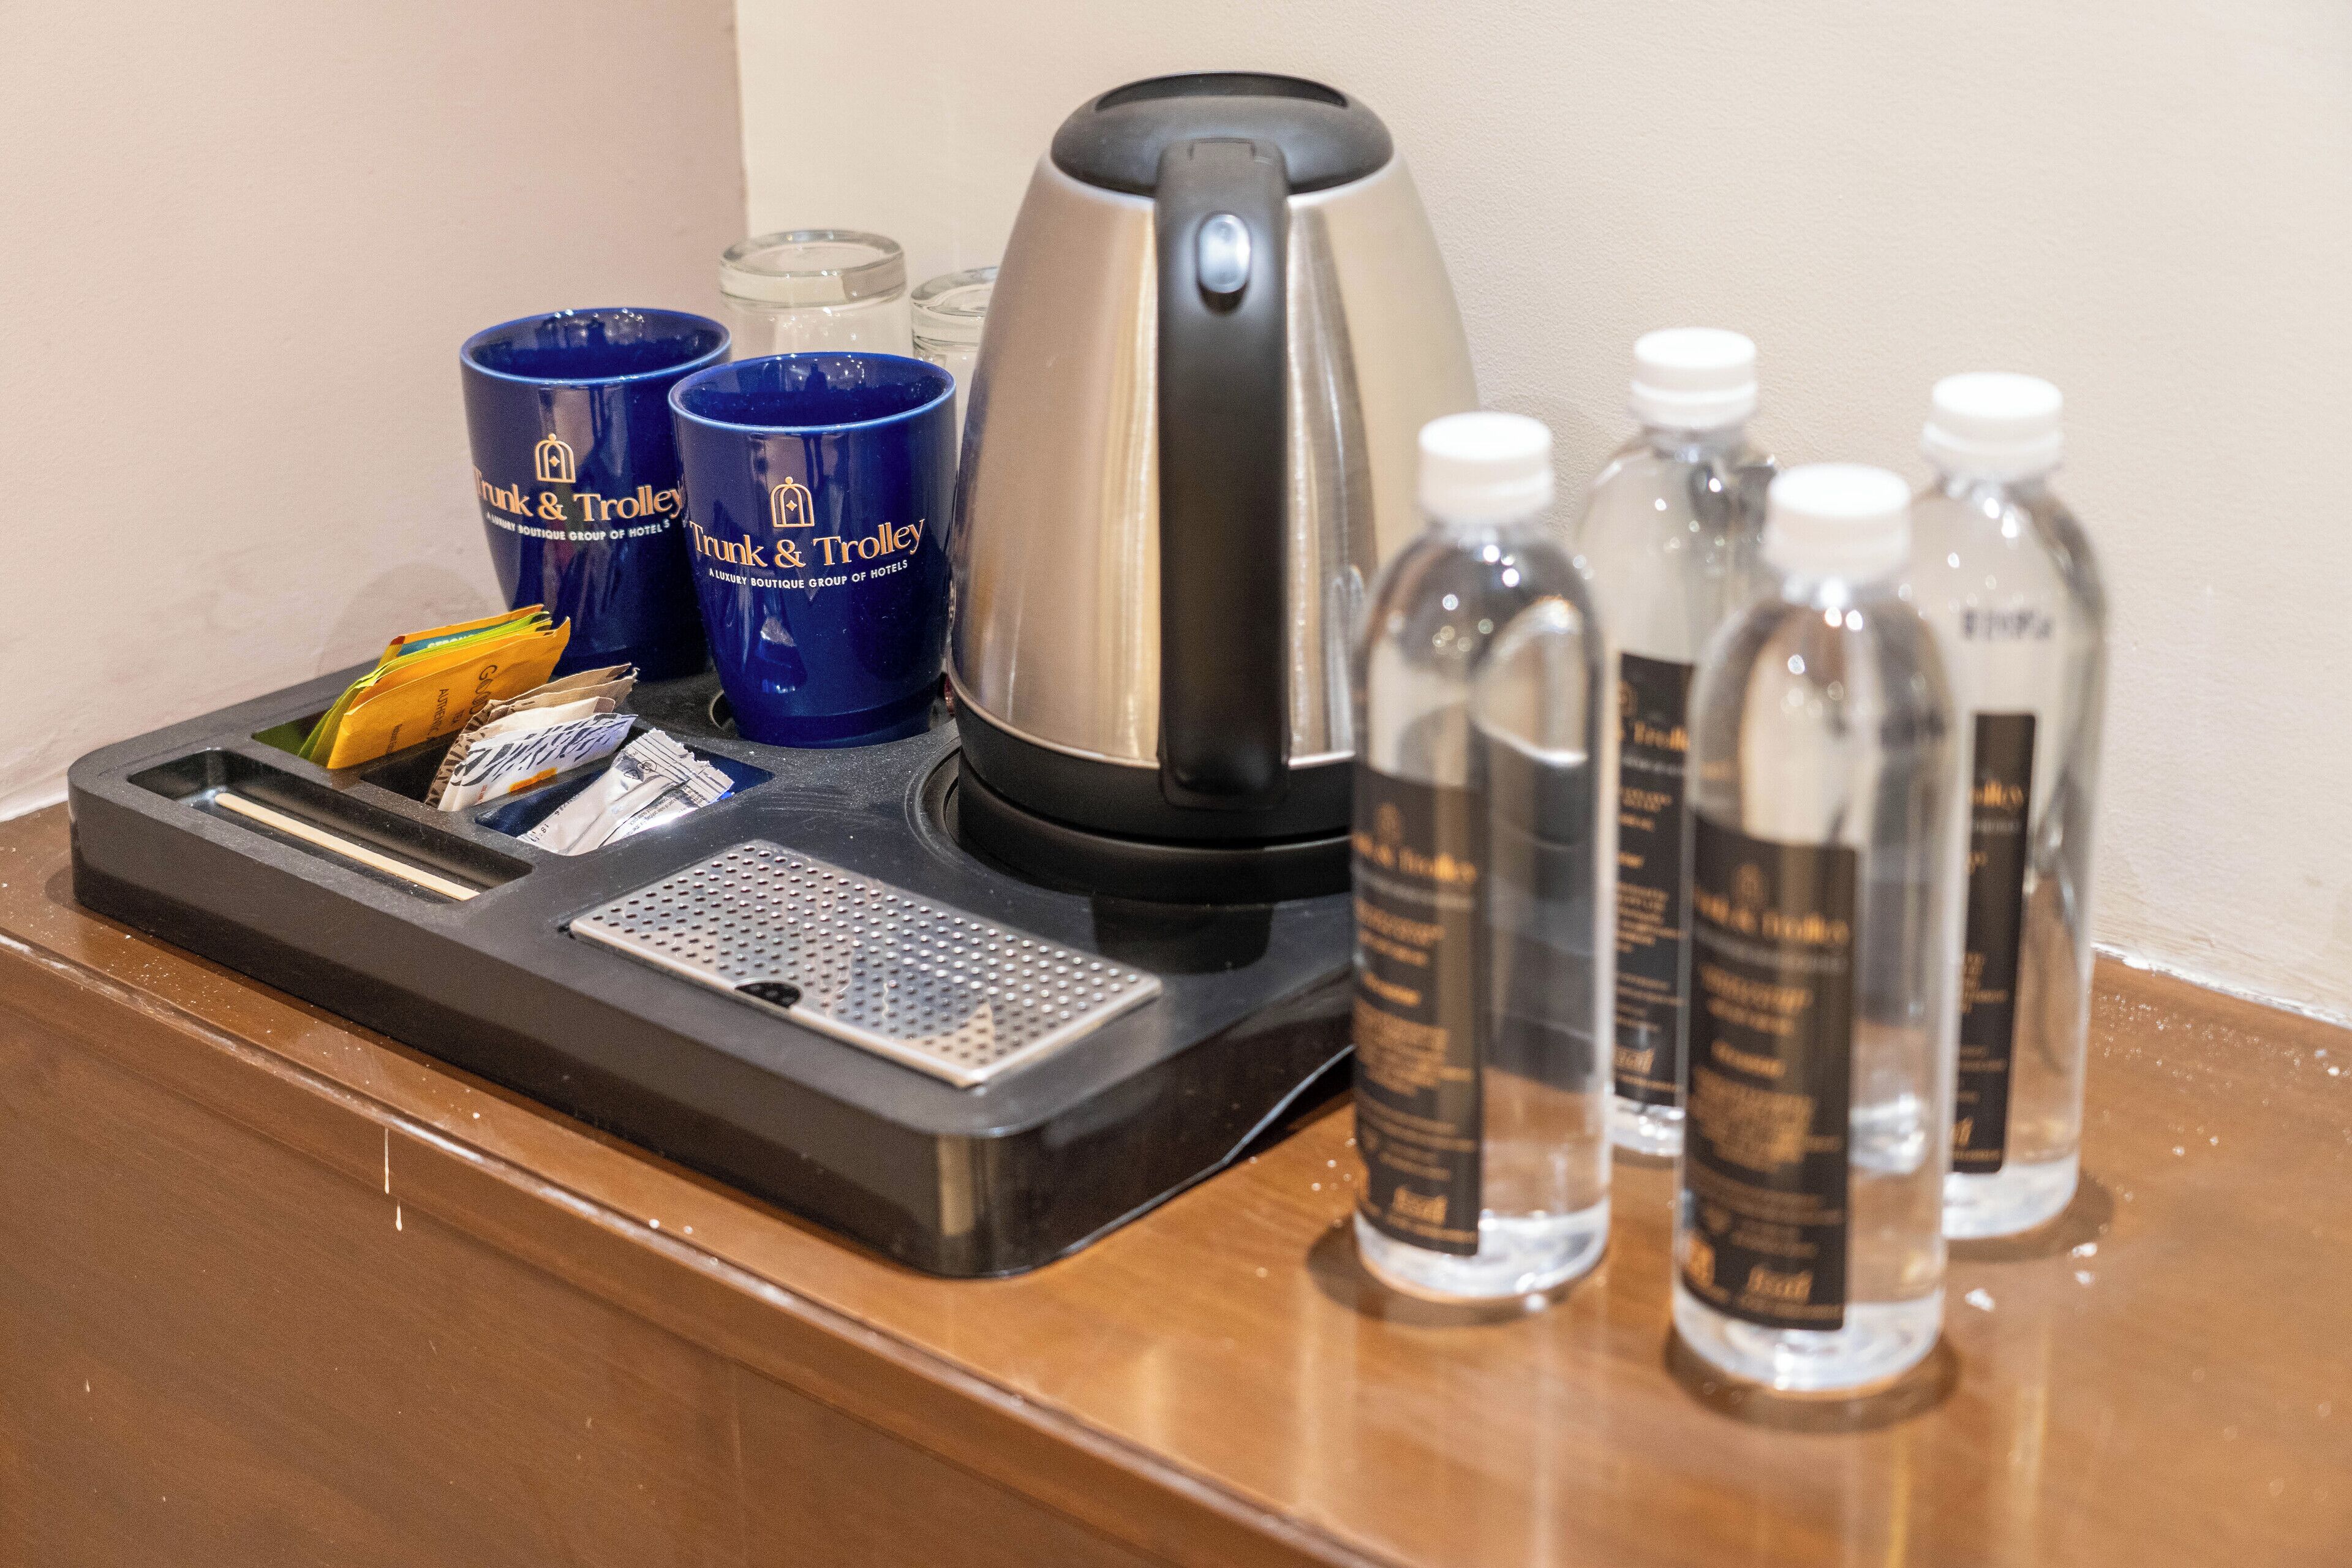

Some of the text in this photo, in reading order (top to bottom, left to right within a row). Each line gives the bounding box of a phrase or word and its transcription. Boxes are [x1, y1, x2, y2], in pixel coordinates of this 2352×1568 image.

[473, 465, 683, 521] Trunk & Trolley
[491, 515, 516, 531] LUXURY
[518, 524, 565, 540] BOUTIQUE
[568, 530, 606, 541] GROUP
[609, 529, 625, 540] OF
[689, 518, 925, 568] Trunk & Trolley
[709, 559, 908, 589] A LUXURY BOUTIQUE GROUP OF HOTELS
